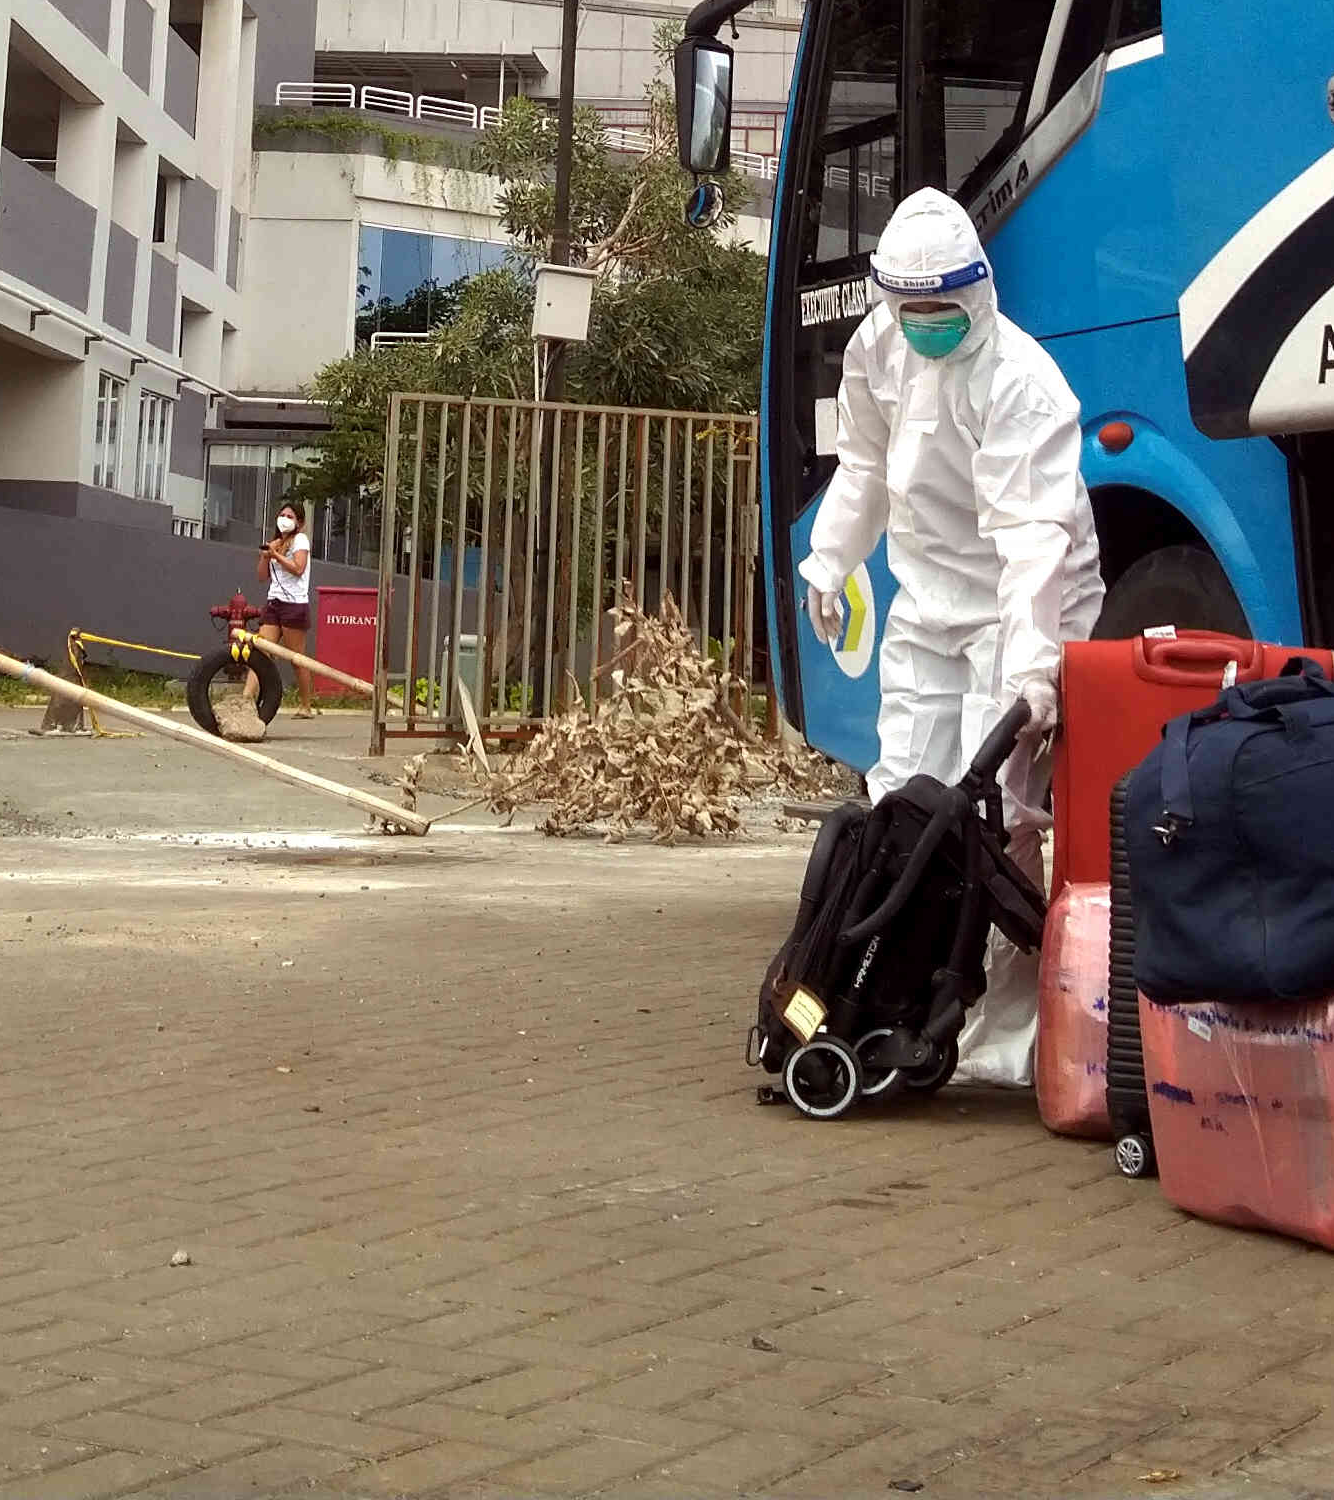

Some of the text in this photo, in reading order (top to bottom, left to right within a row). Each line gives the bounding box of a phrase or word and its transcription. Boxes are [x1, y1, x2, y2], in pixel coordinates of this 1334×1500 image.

[800, 279, 866, 326] EXECUTIVE CLASS
[326, 614, 377, 626] HYDRANT
